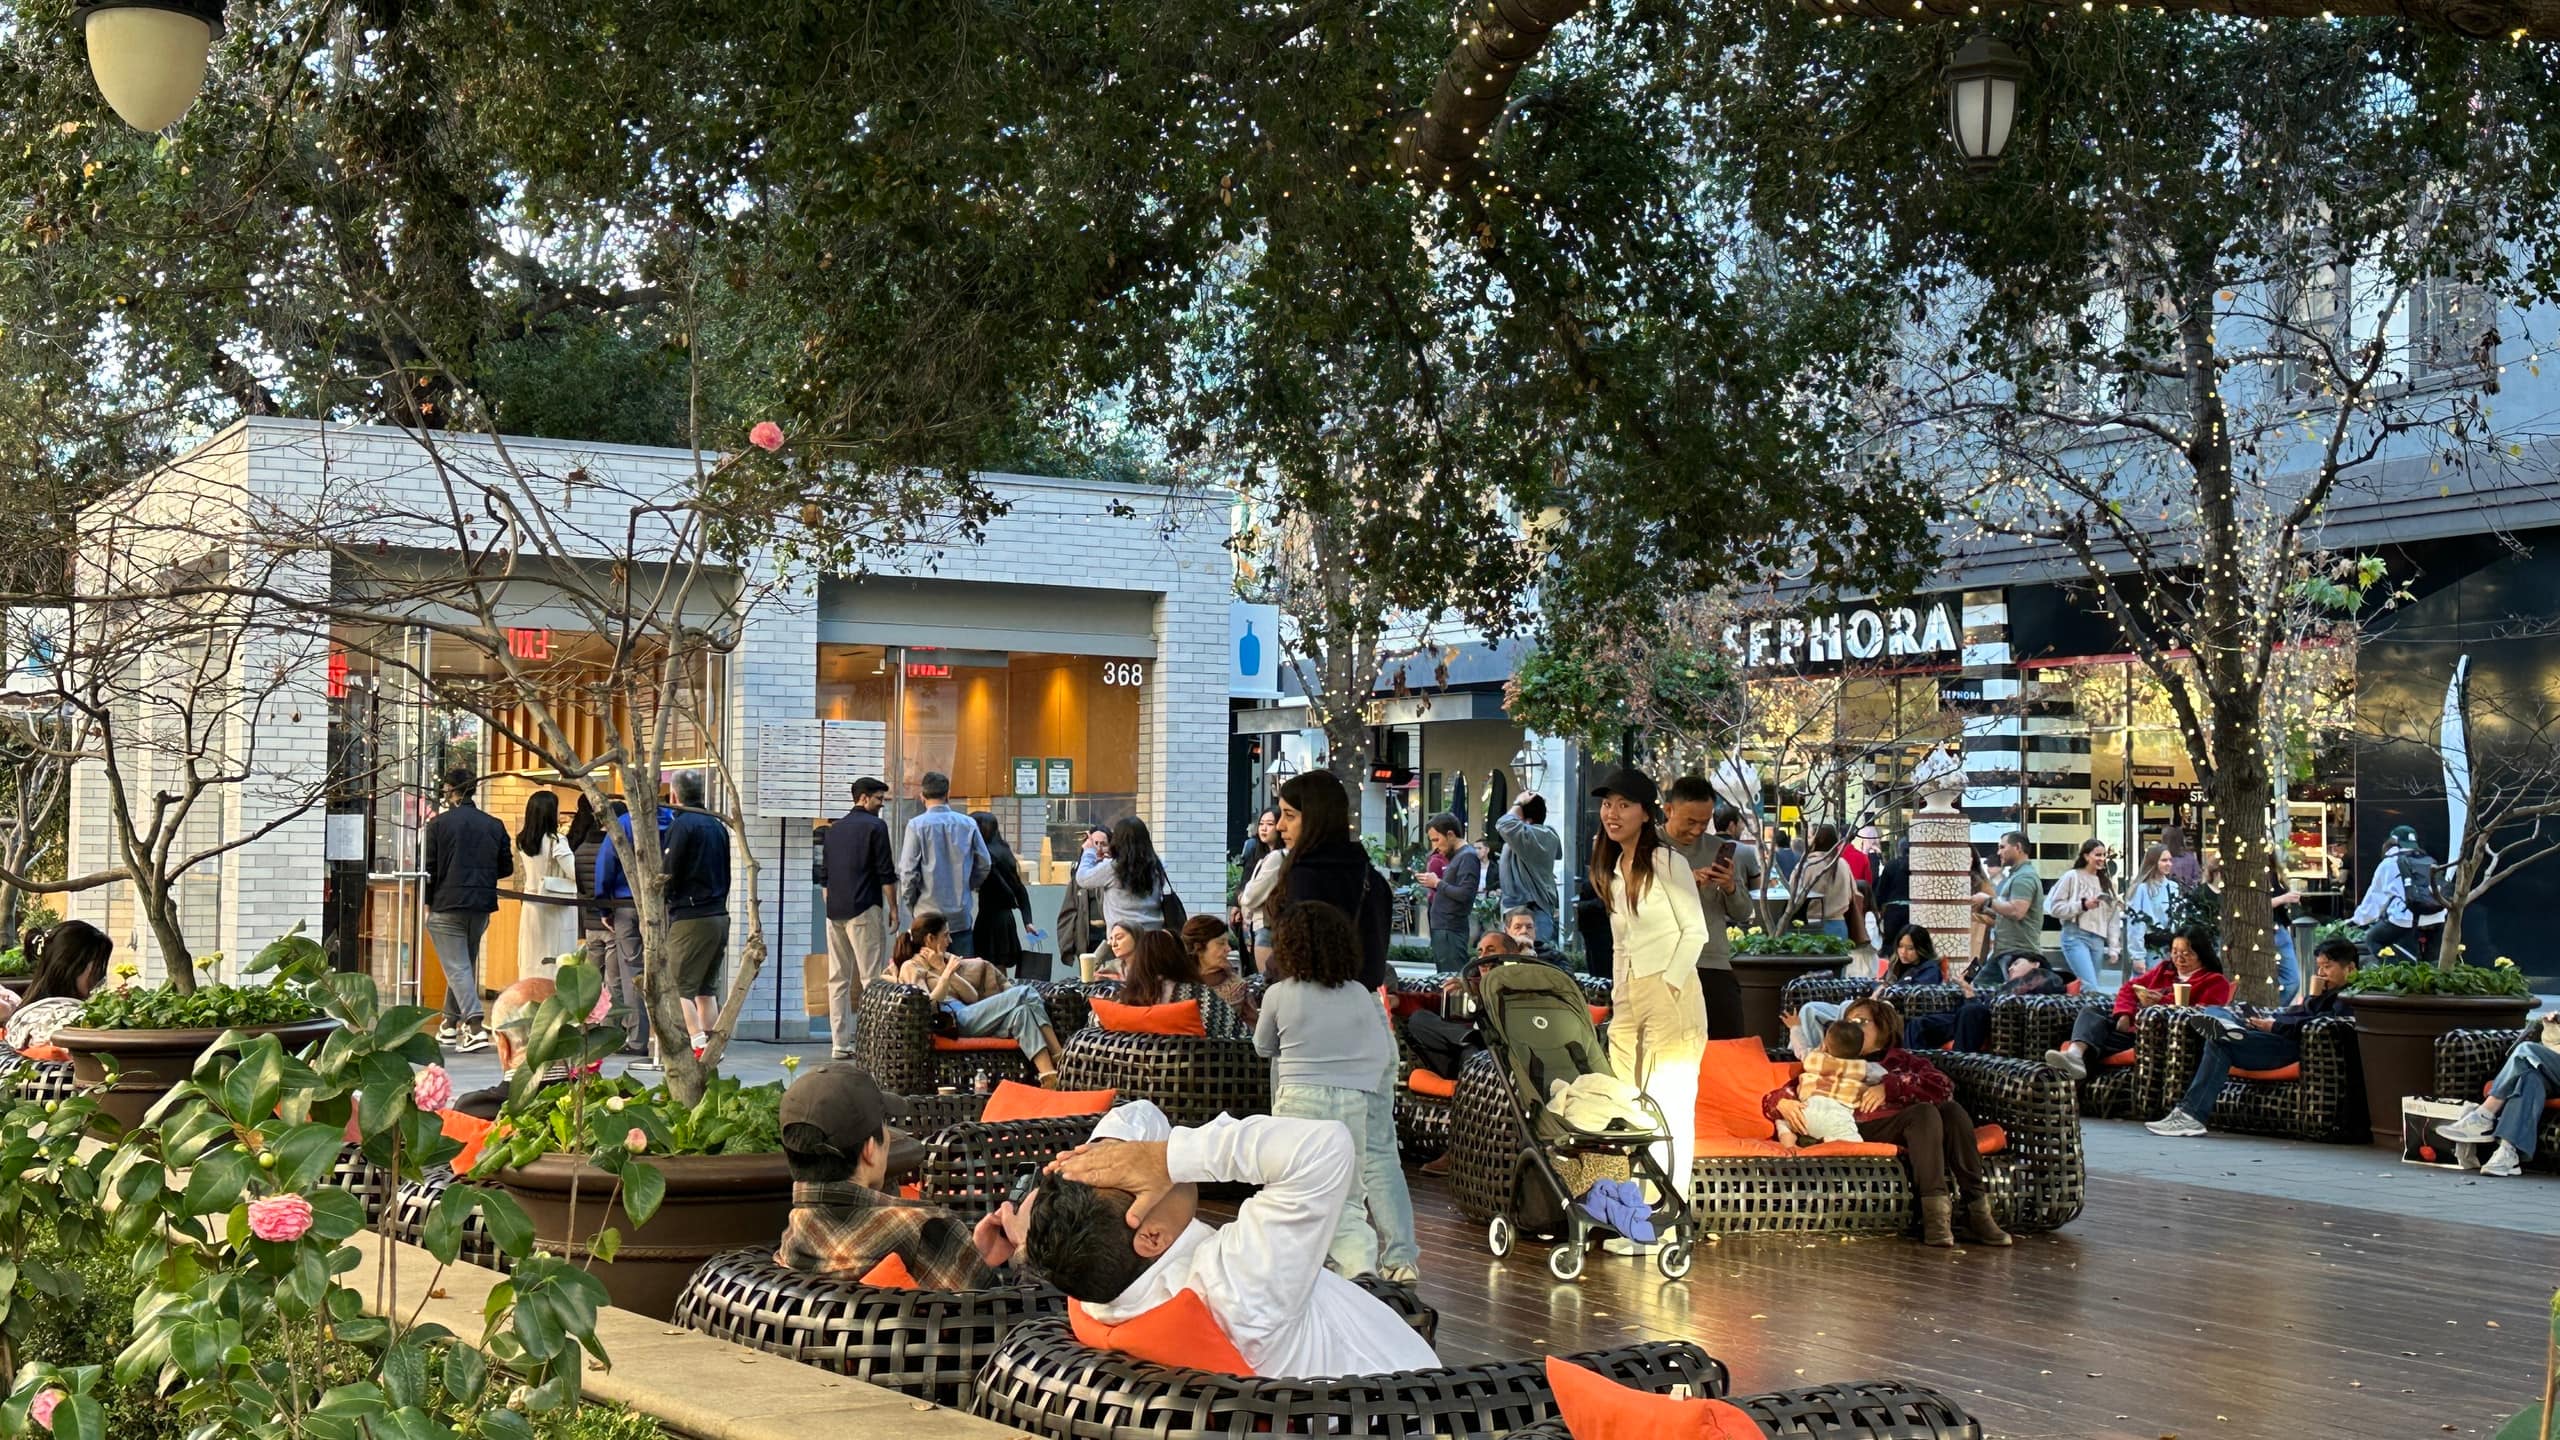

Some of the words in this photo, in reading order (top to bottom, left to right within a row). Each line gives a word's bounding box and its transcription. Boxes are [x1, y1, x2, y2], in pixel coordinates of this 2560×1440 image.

[1721, 602, 1957, 669] SEPHORA
[1103, 661, 1143, 687] 368
[1941, 690, 1981, 700] SEPHORA
